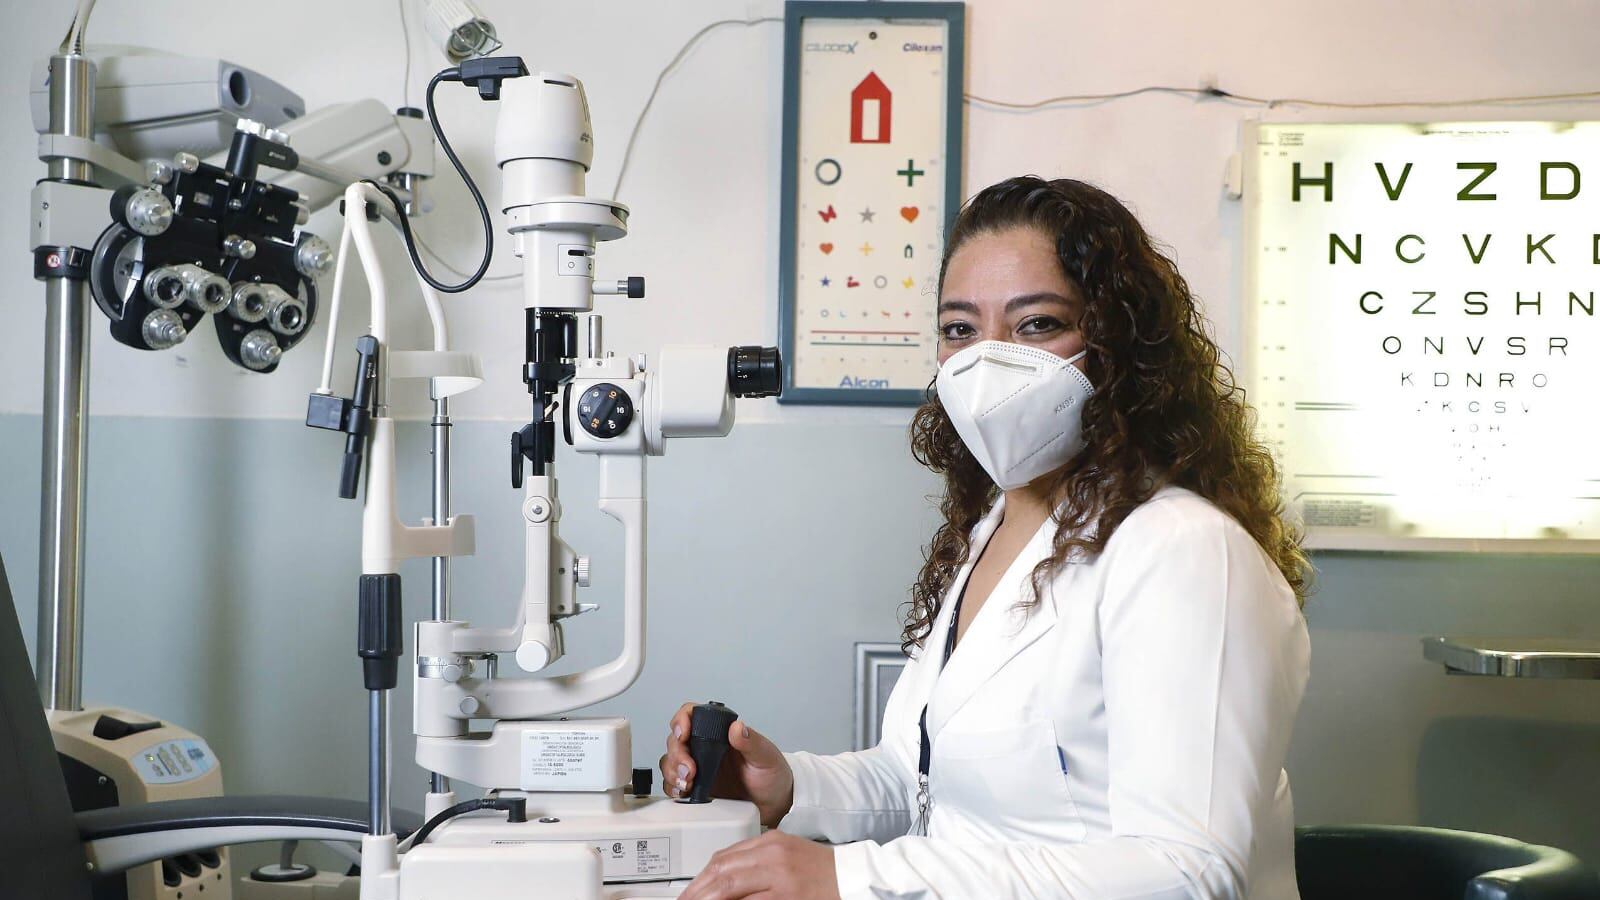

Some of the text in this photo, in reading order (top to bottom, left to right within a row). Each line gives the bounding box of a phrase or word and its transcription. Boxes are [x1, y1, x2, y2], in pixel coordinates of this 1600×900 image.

[1292, 161, 1582, 202] H V Z D
[1329, 233, 1362, 265] N
[1395, 234, 1426, 264] C
[1462, 233, 1493, 264] V
[1526, 233, 1557, 264] K
[1359, 291, 1595, 317] C Z S H N
[1382, 336, 1569, 356] O N V S R
[840, 375, 889, 389] Alcon
[1401, 372, 1548, 388] K D N R O
[608, 391, 617, 399] 10
[616, 406, 625, 414] 16
[1054, 396, 1077, 413] KN95
[1468, 401, 1480, 413] C
[1494, 401, 1507, 414] S
[590, 418, 600, 429] 25
[608, 419, 617, 429] 40
